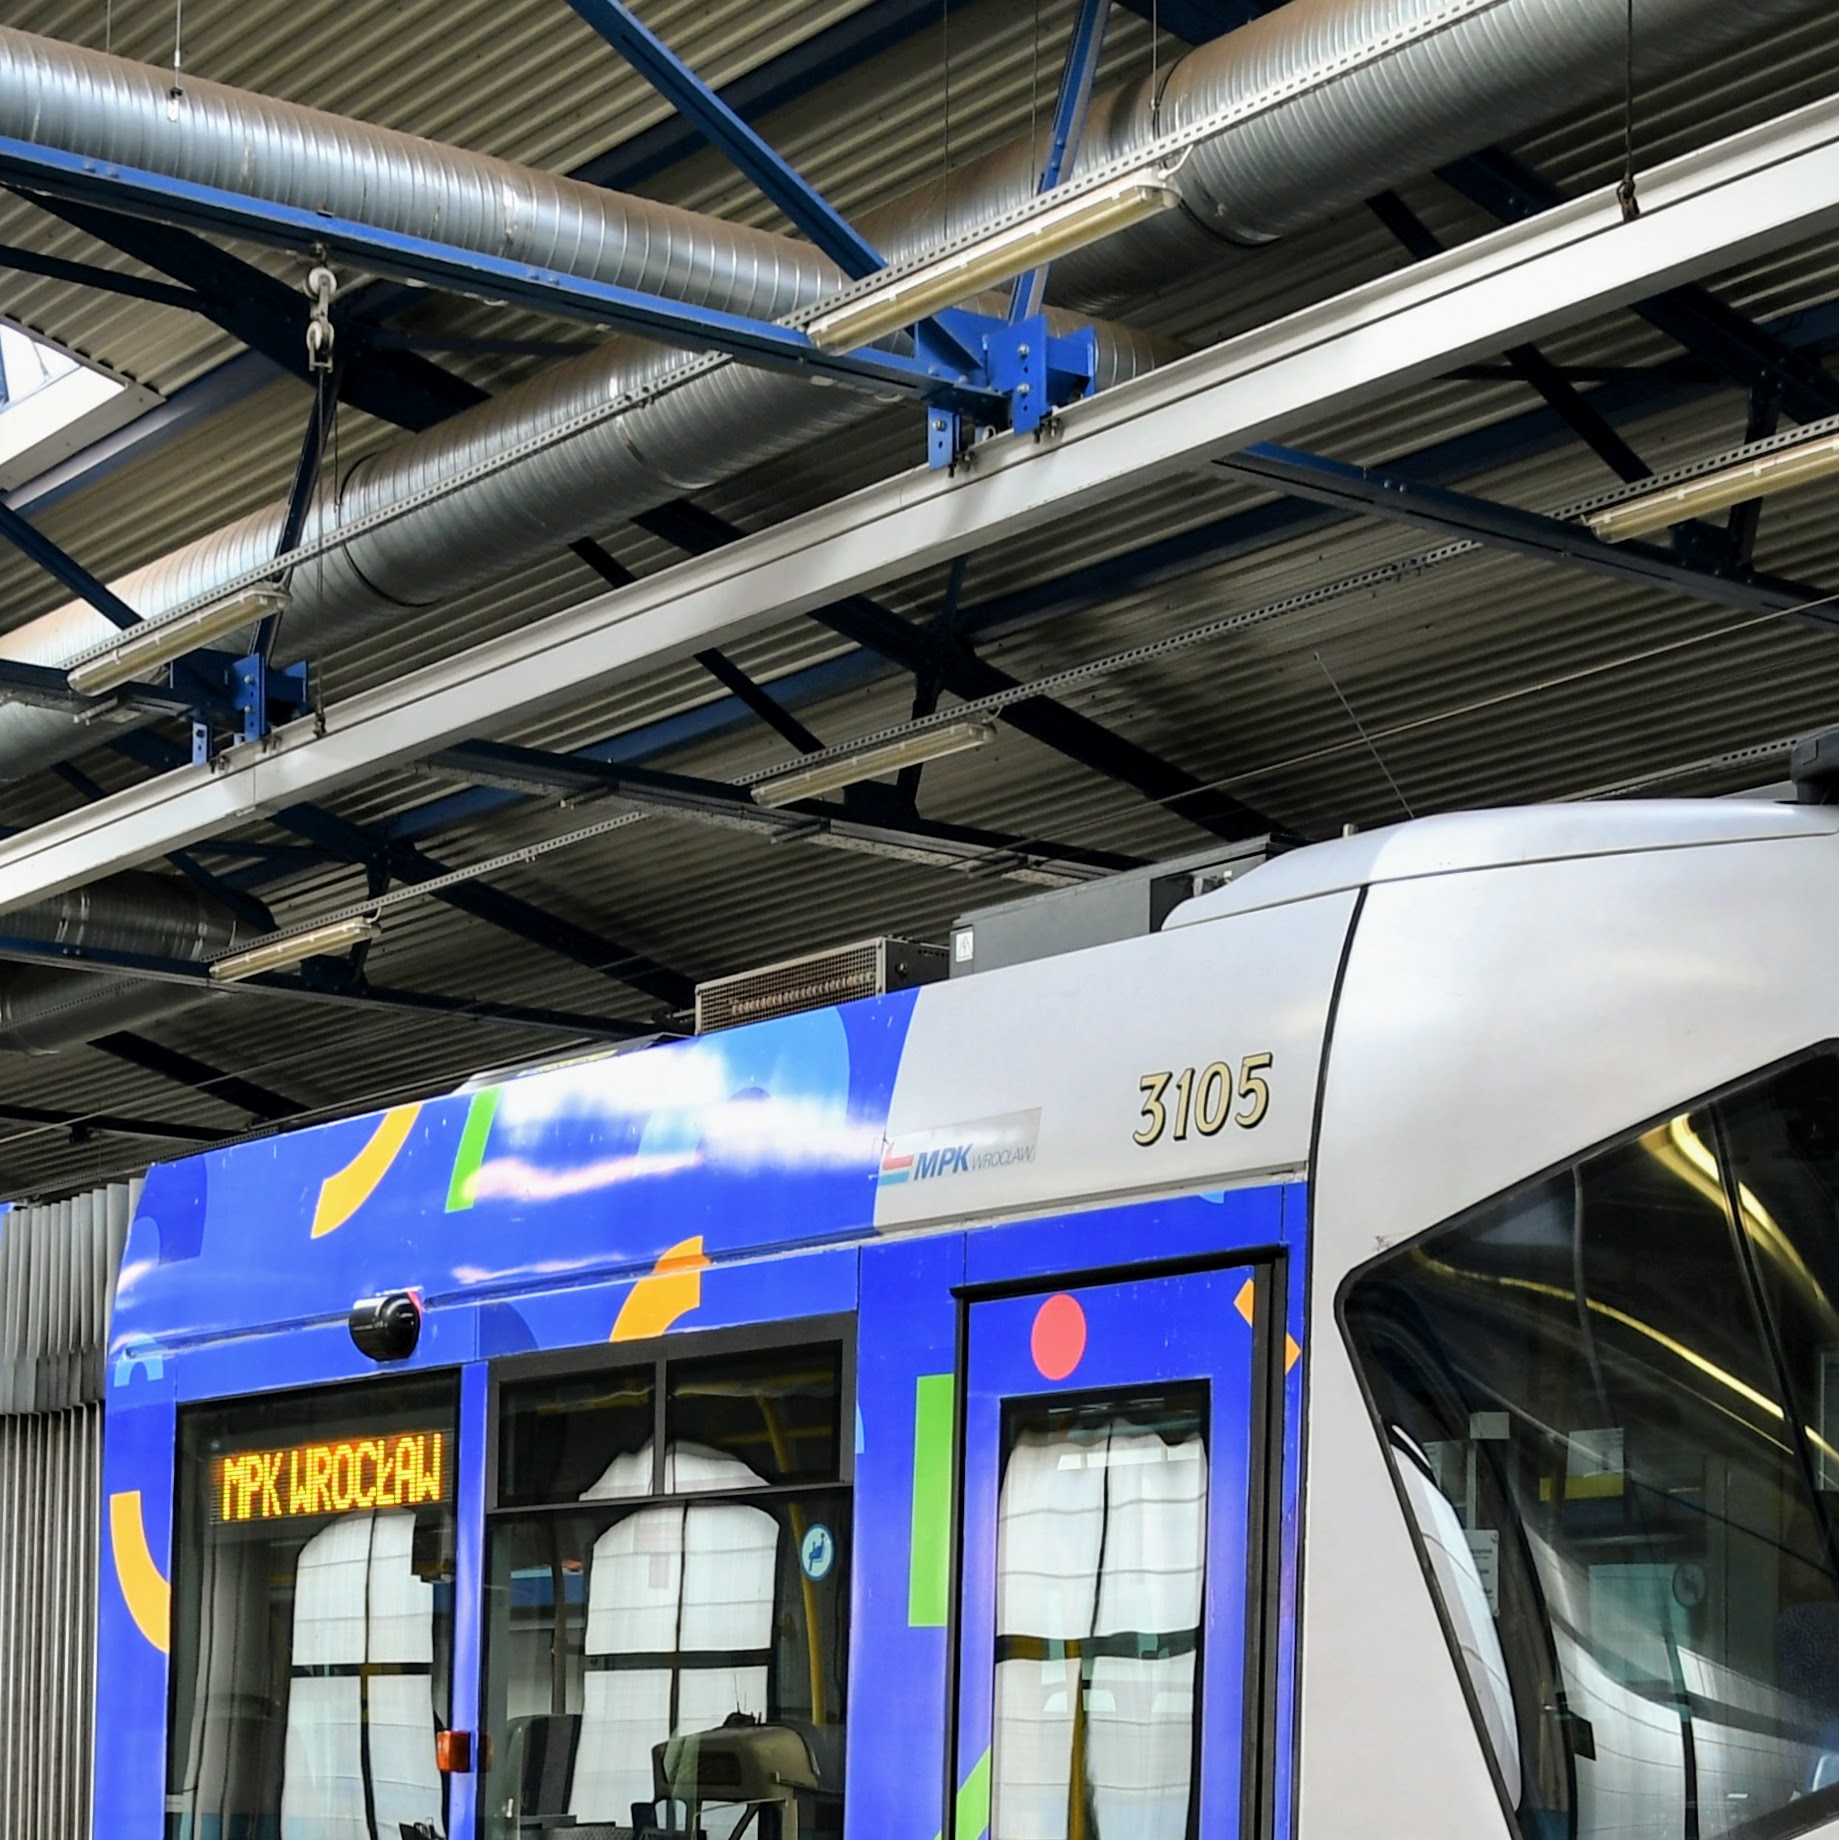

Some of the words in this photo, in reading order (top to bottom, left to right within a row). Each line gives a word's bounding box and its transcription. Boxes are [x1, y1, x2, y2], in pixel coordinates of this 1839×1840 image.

[1132, 1052, 1273, 1147] 3105
[913, 1143, 974, 1181] MPK
[223, 1452, 283, 1520] MPK
